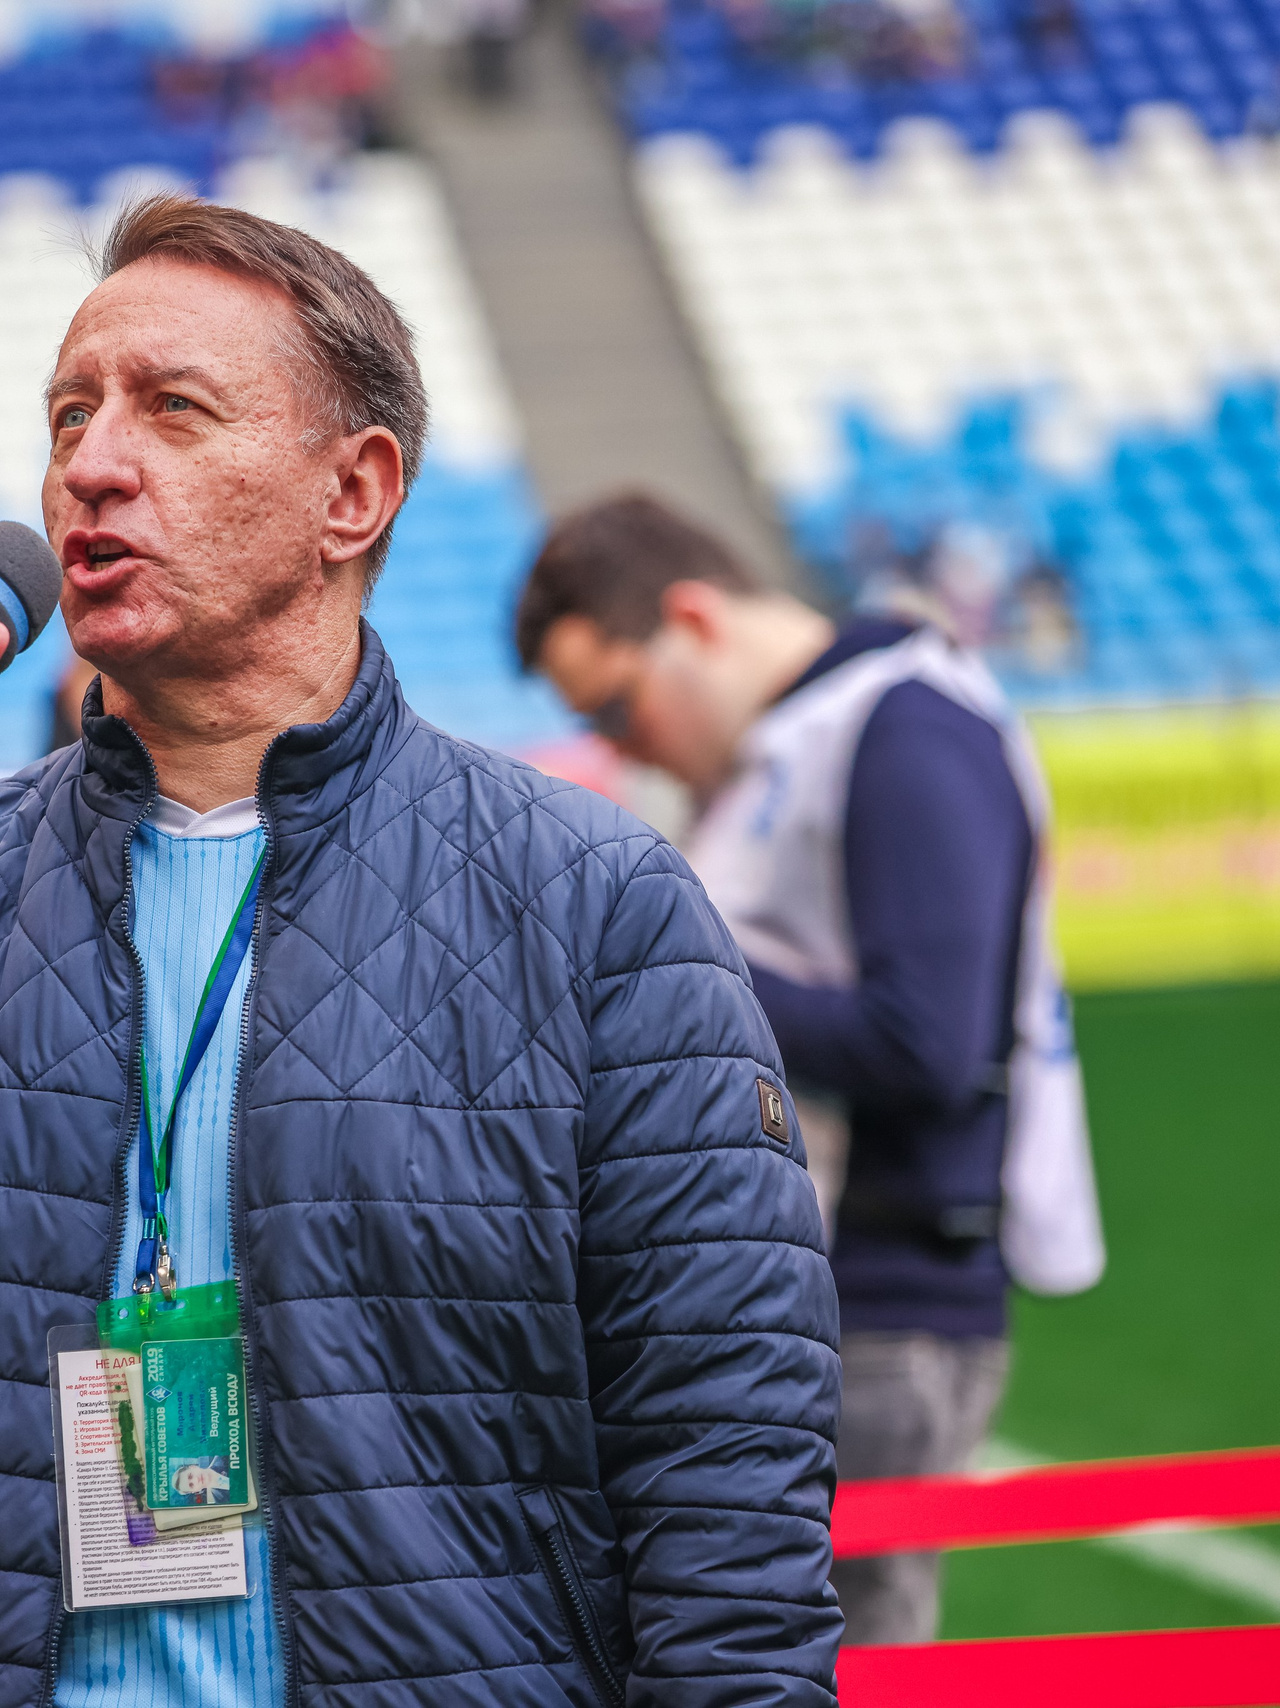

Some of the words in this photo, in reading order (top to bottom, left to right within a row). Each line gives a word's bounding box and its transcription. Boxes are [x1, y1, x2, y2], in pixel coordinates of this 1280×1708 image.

[96, 1359, 110, 1369] НЕ
[113, 1357, 136, 1368] ДЛЯ
[147, 1348, 158, 1382] 2019
[207, 1386, 220, 1437] Ведущий
[226, 1373, 239, 1416] ВСЮДУ
[156, 1407, 167, 1453] СОВЕТОВ
[228, 1418, 240, 1470] ПРОХОД
[158, 1456, 169, 1502] КРЫЛЬЯ
